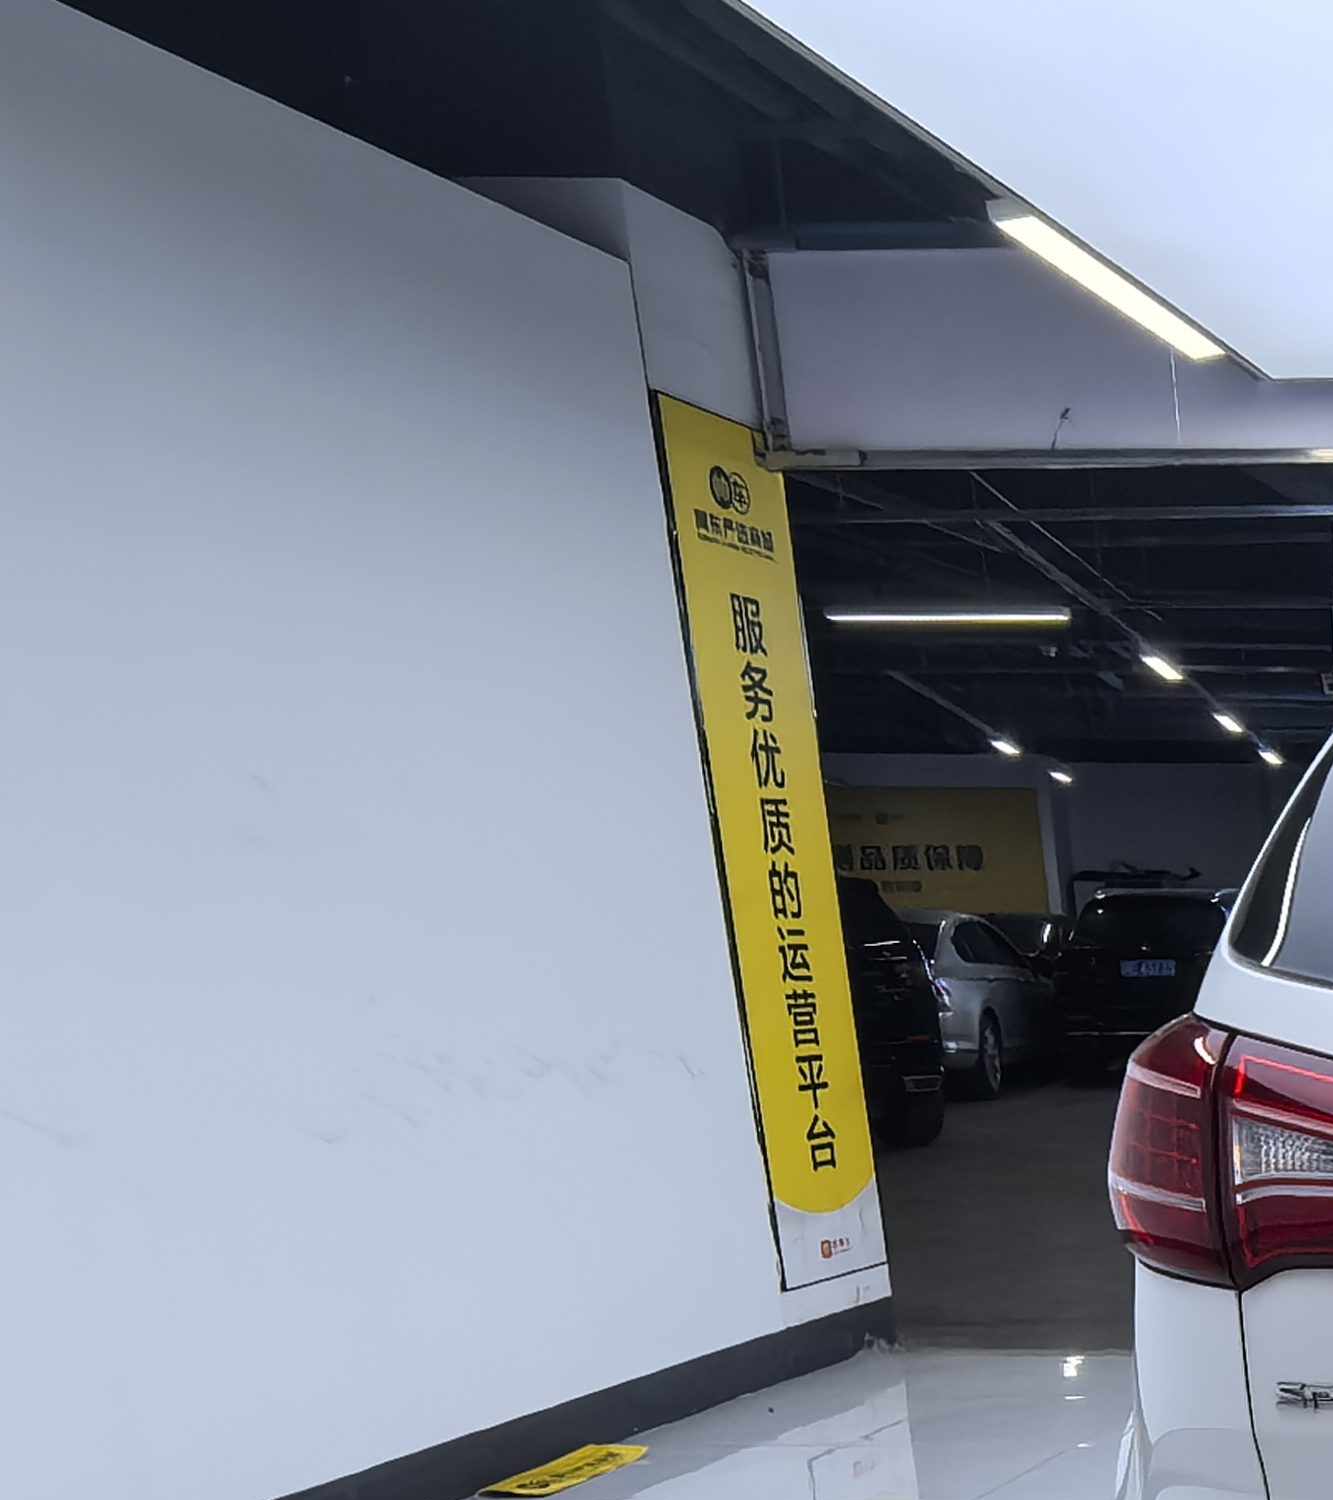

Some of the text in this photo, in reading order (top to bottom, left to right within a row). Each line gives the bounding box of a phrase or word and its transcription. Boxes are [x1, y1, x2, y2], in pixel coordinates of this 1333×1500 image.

[729, 591, 838, 1172] 服务优质的运营平台
